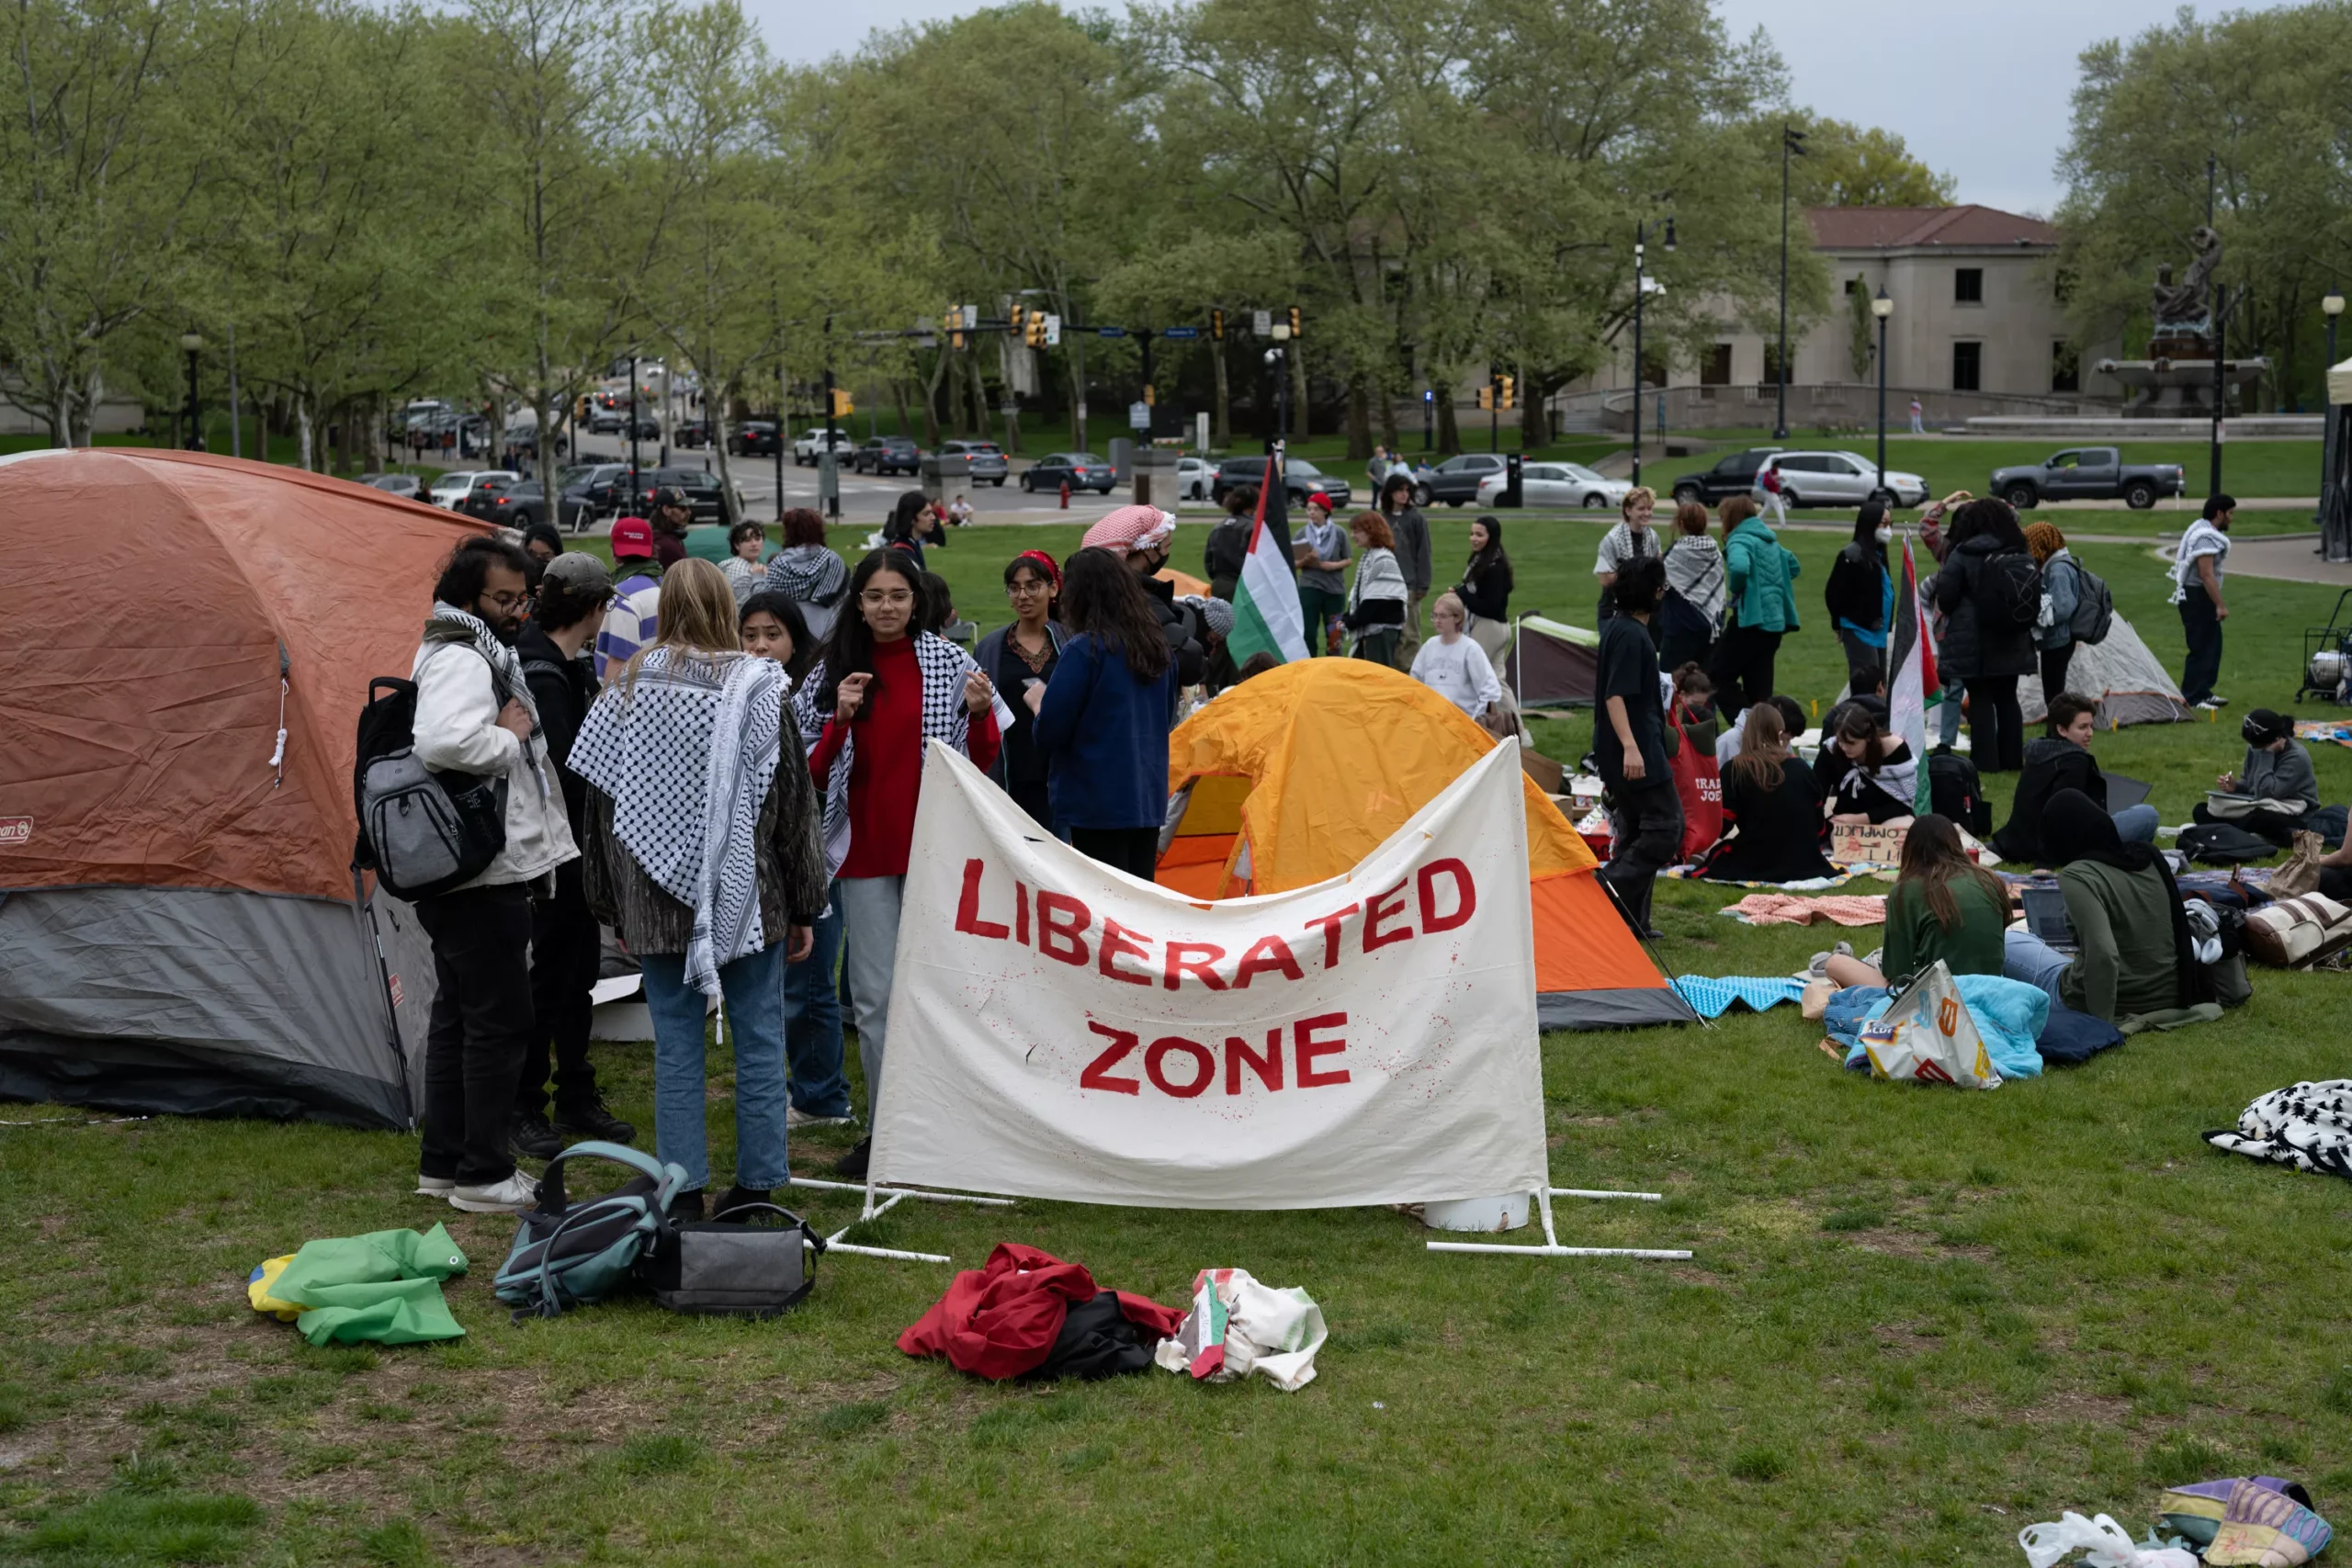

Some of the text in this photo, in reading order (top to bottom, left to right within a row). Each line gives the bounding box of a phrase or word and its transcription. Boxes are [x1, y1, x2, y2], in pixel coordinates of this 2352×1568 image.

[1695, 778, 1722, 790] TRAD
[1701, 790, 1723, 802] JOE
[955, 857, 1477, 992] LIBERATED
[1079, 1011, 1352, 1100] ZONE
